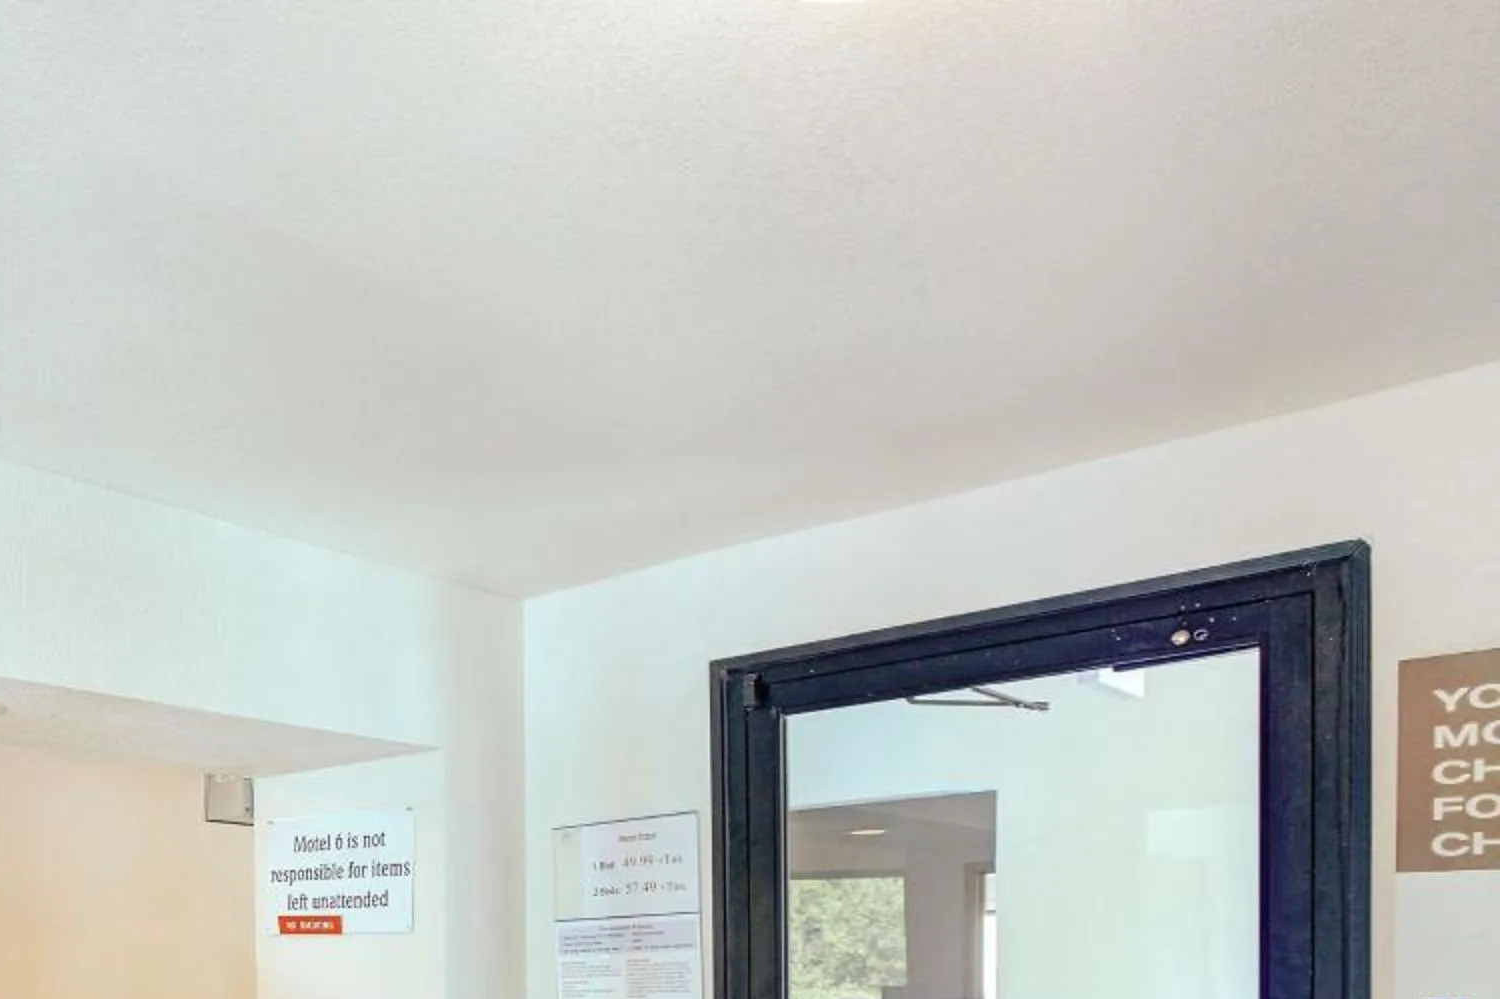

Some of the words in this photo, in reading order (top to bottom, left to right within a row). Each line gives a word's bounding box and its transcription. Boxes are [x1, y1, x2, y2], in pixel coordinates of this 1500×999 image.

[293, 834, 331, 853] Motel
[335, 833, 343, 850] 6
[347, 832, 359, 849] is
[363, 831, 387, 848] not
[271, 863, 344, 886] responsible
[348, 861, 368, 879] for
[371, 860, 411, 878] items
[287, 893, 309, 911] left
[312, 890, 389, 909] unattended
